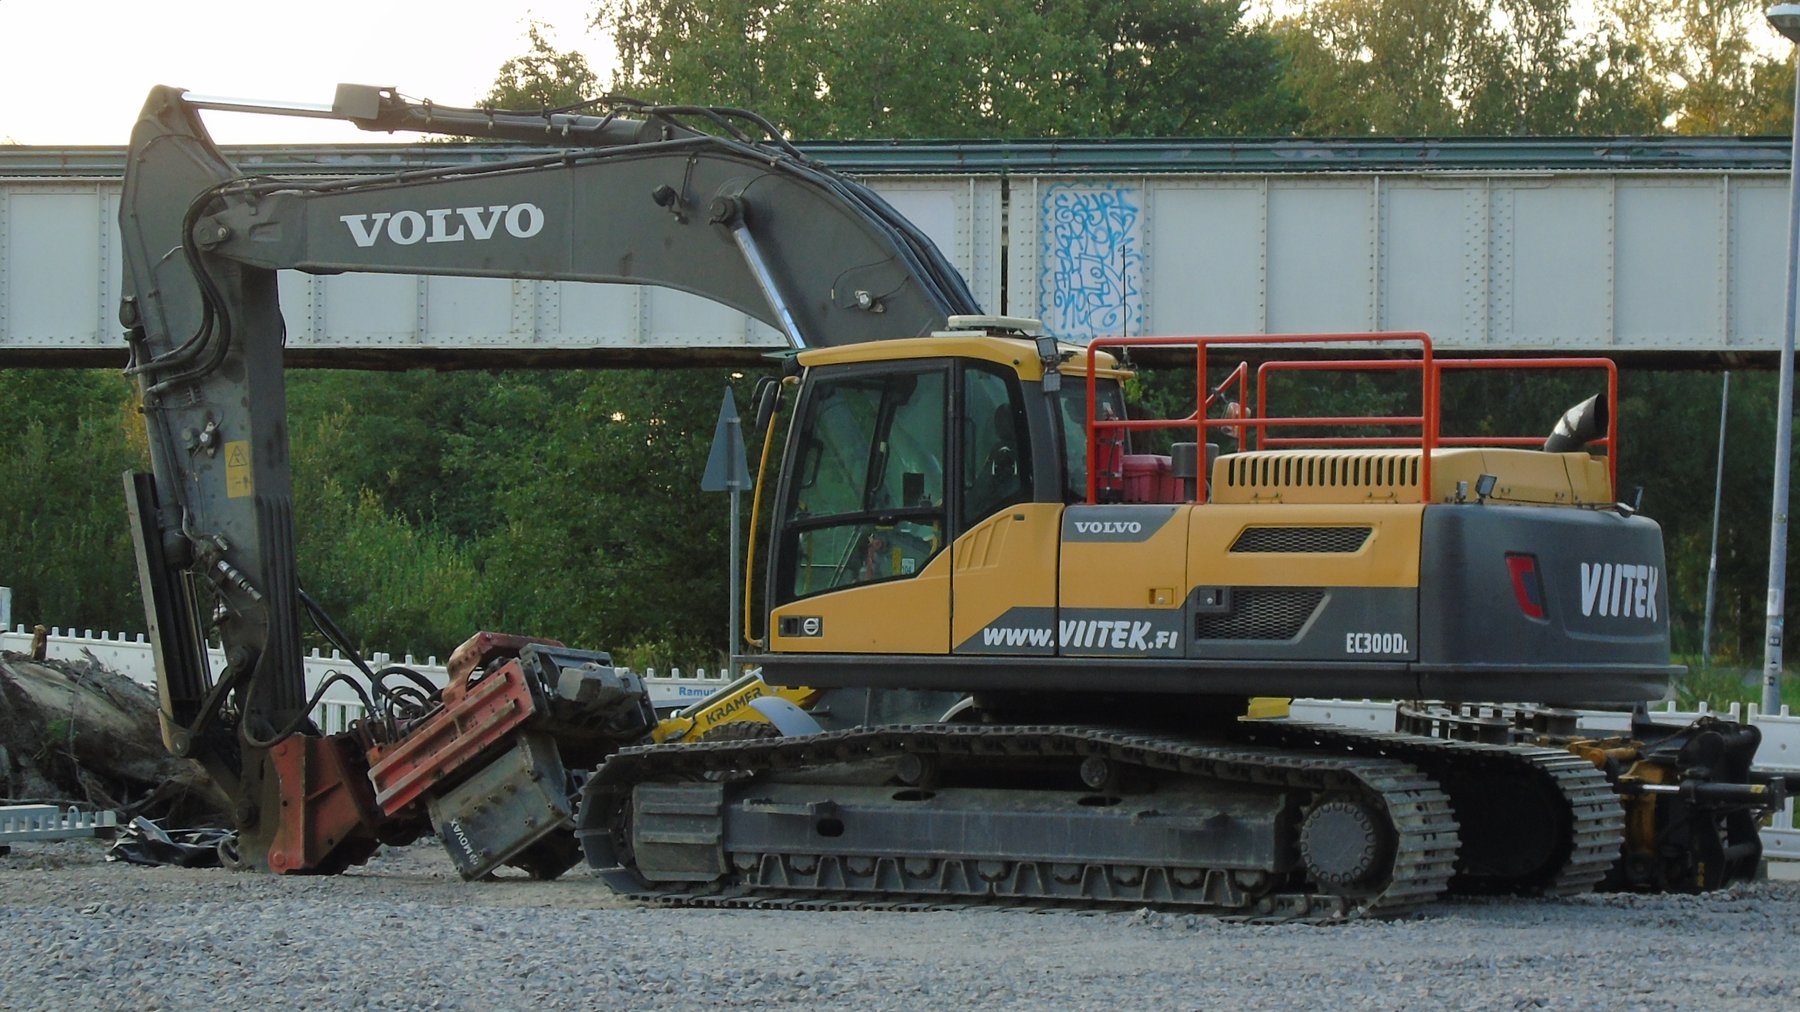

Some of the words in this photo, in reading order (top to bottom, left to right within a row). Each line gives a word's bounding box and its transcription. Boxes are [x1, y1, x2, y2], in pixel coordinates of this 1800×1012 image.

[339, 202, 545, 248] VOLVO
[1074, 521, 1142, 534] VOLVO
[1580, 562, 1659, 623] VIITEK
[705, 687, 763, 725] KRAMER
[450, 819, 473, 855] MOVAX
